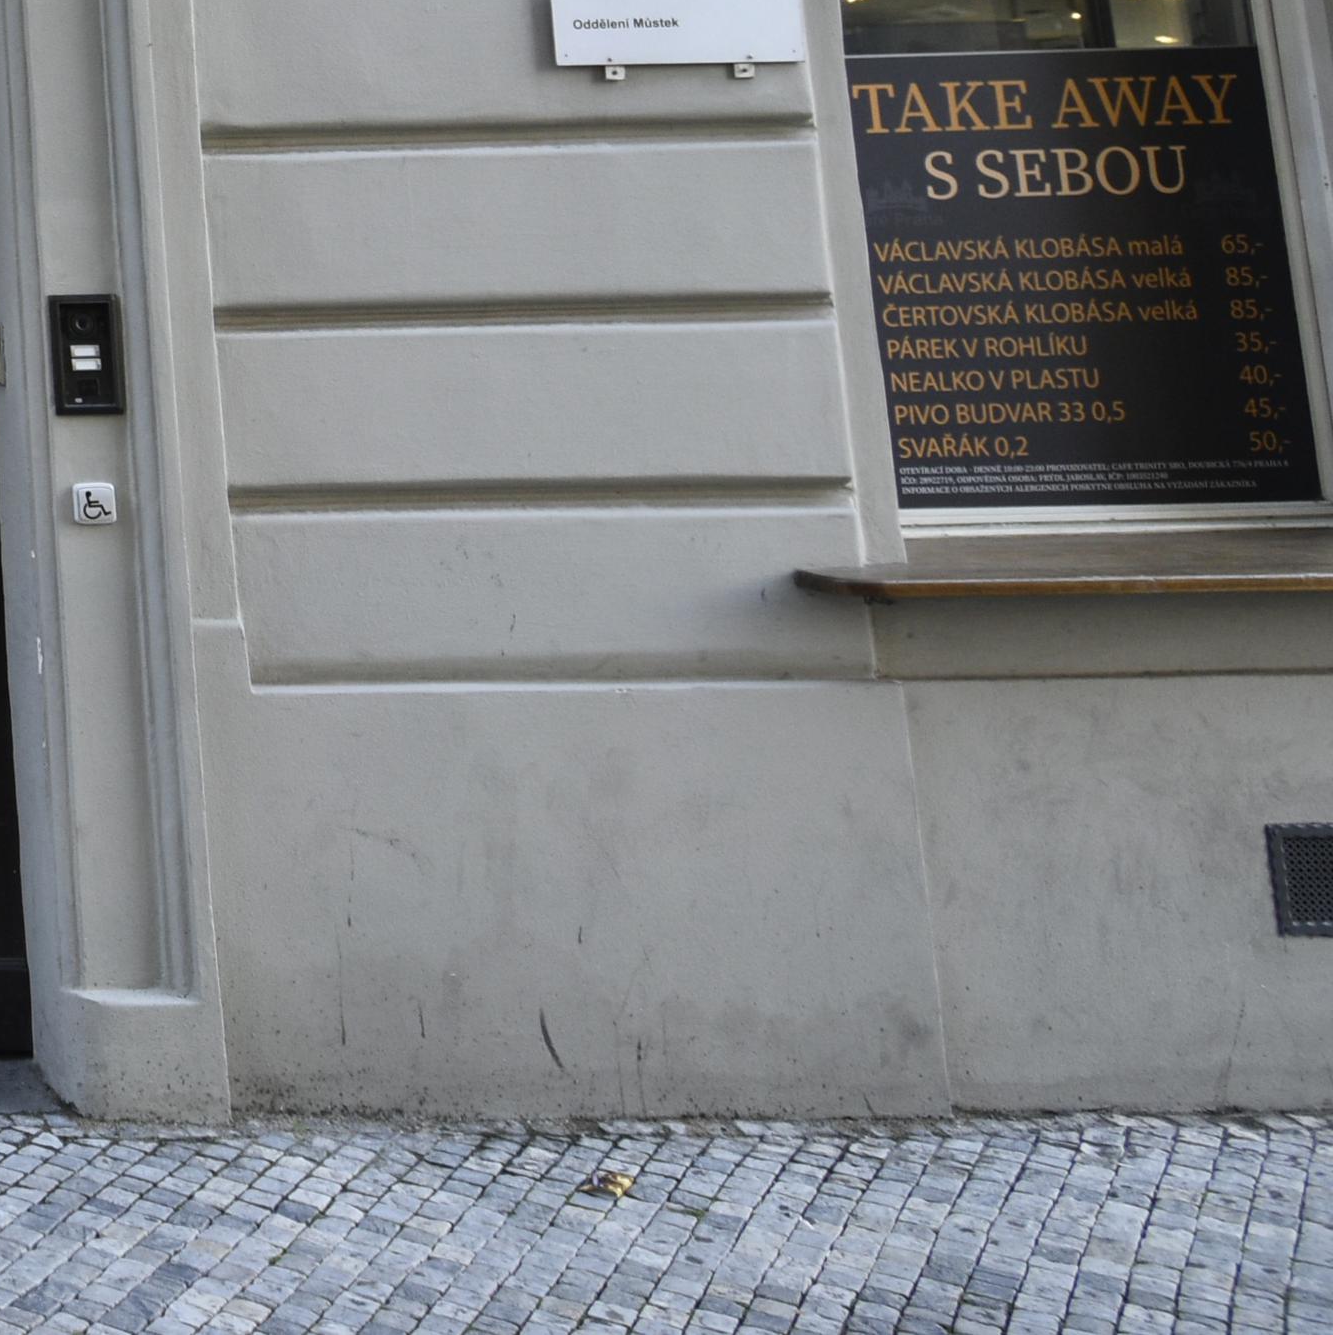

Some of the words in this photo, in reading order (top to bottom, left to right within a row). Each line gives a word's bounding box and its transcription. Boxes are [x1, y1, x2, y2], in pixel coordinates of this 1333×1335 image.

[573, 18, 630, 30] Oddělení
[633, 17, 680, 29] Můstek
[852, 80, 1033, 134] TAKE
[1051, 74, 1237, 128] AWAY
[924, 150, 959, 201] S
[975, 146, 1187, 199] SEBOU
[873, 235, 1009, 263] VÁCLAVSKÁ
[1014, 234, 1122, 259] KLOBÁSA
[1129, 234, 1184, 257] malá
[1221, 234, 1263, 255] 65,-
[877, 268, 1014, 295] VÁCLAVSKÁ
[1019, 266, 1126, 292] KLOBÁSA
[1132, 266, 1193, 289] velká
[1226, 266, 1268, 288] 85,-
[883, 300, 1023, 328] ČERTOVSKÁ
[1024, 298, 1132, 325] KLOBÁSA
[1137, 299, 1198, 322] velká
[1230, 299, 1273, 321] 85,-
[887, 335, 959, 360] PÁREK
[962, 338, 978, 358] V
[985, 334, 1088, 358] ROHLÍKU
[1235, 331, 1277, 354] 35,-
[890, 369, 984, 393] NEALKO
[988, 369, 1005, 391] V
[1012, 368, 1100, 390] PLASTU
[1239, 364, 1282, 387] 40,-
[894, 403, 950, 426] PIVO
[956, 402, 1053, 425] BUDVAR
[1058, 401, 1085, 423] 33
[1091, 400, 1126, 425] 0,5
[1244, 397, 1286, 420] 45,-
[898, 433, 990, 459] SVAŘÁK
[994, 436, 1029, 460] 0,2
[1249, 430, 1292, 454] 50,-
